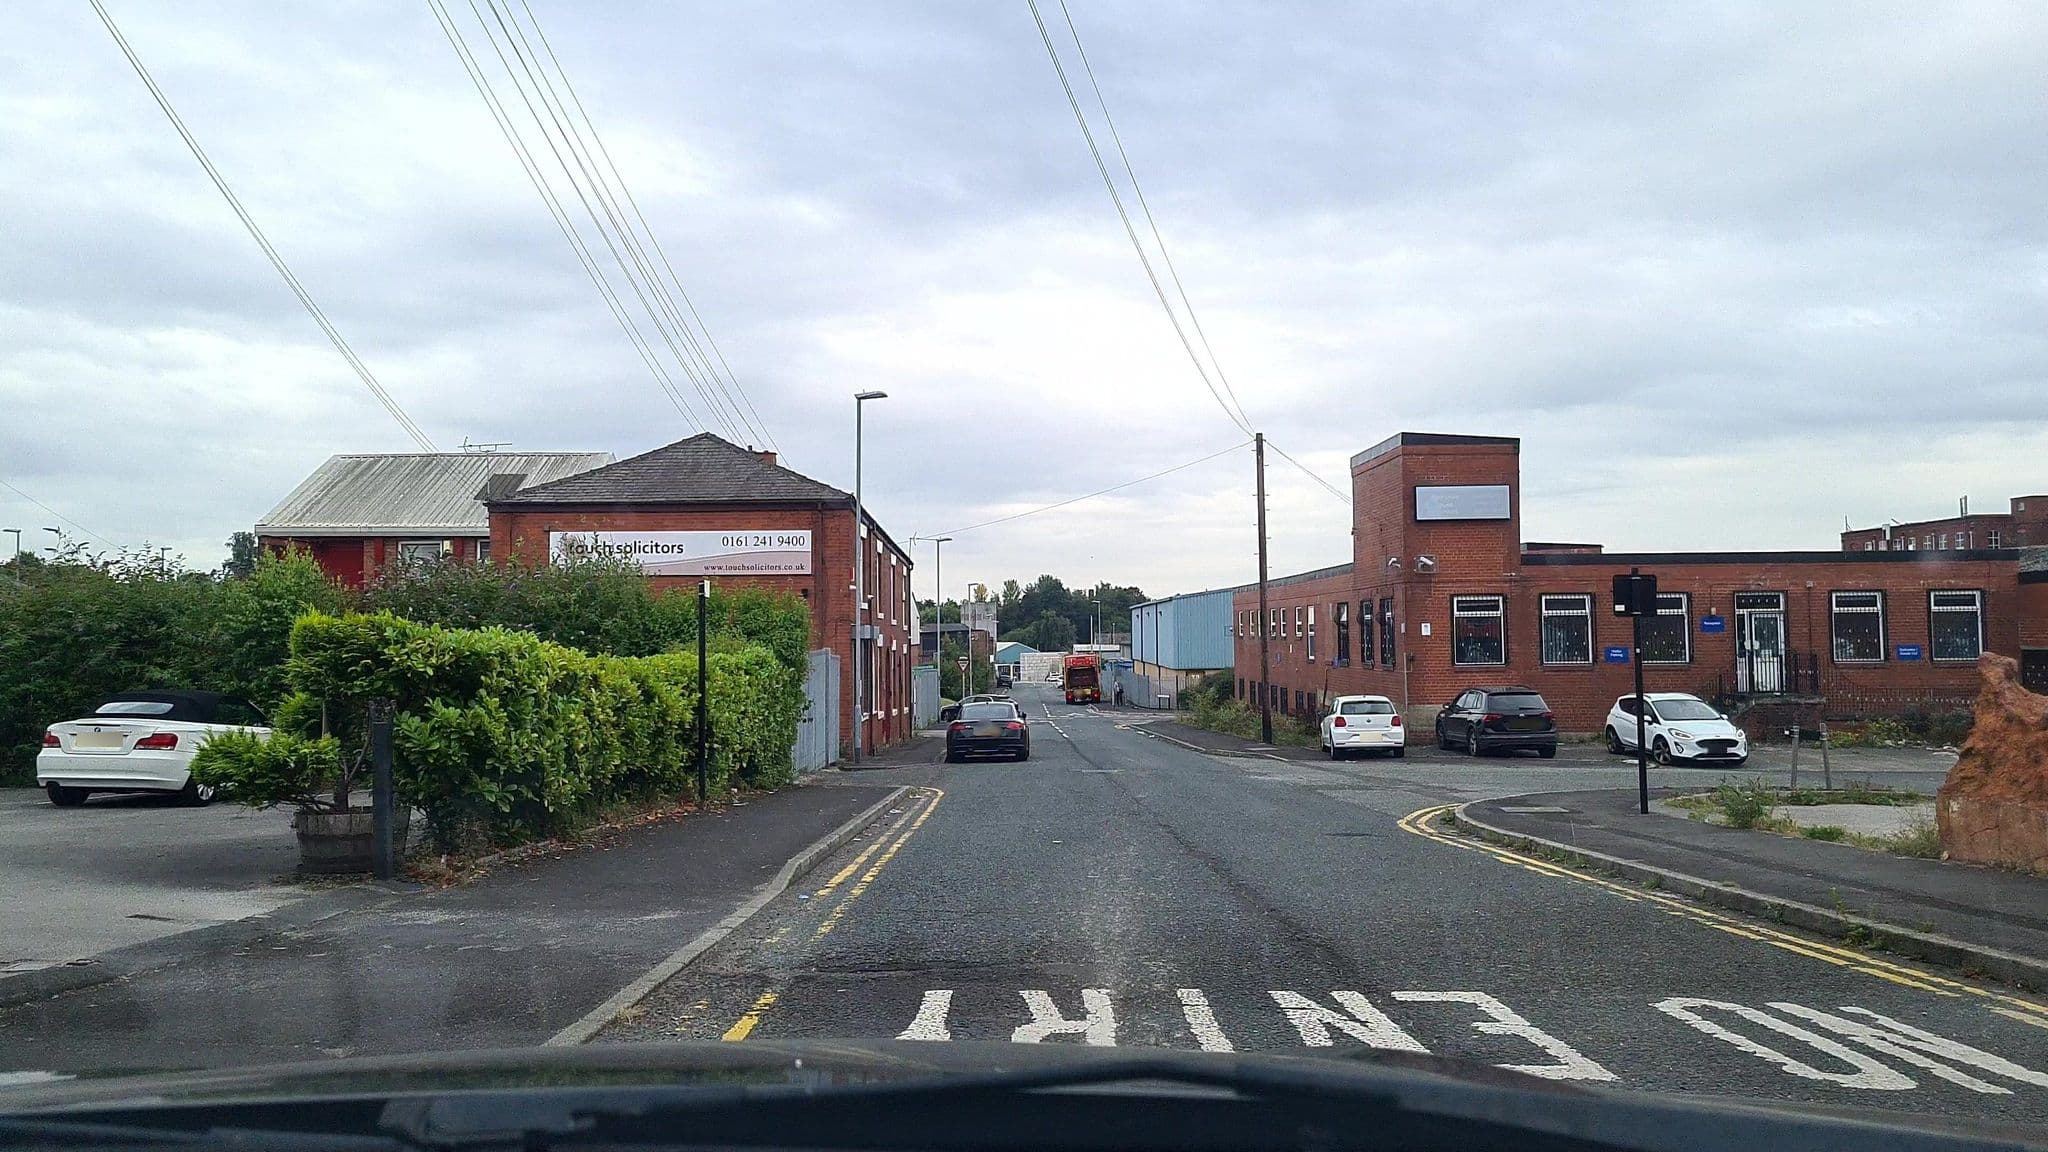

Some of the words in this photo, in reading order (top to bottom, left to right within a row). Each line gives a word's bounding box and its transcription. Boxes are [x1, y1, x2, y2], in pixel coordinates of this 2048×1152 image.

[721, 535, 748, 547] 0161
[753, 535, 773, 547] 241
[777, 535, 805, 547] 9400
